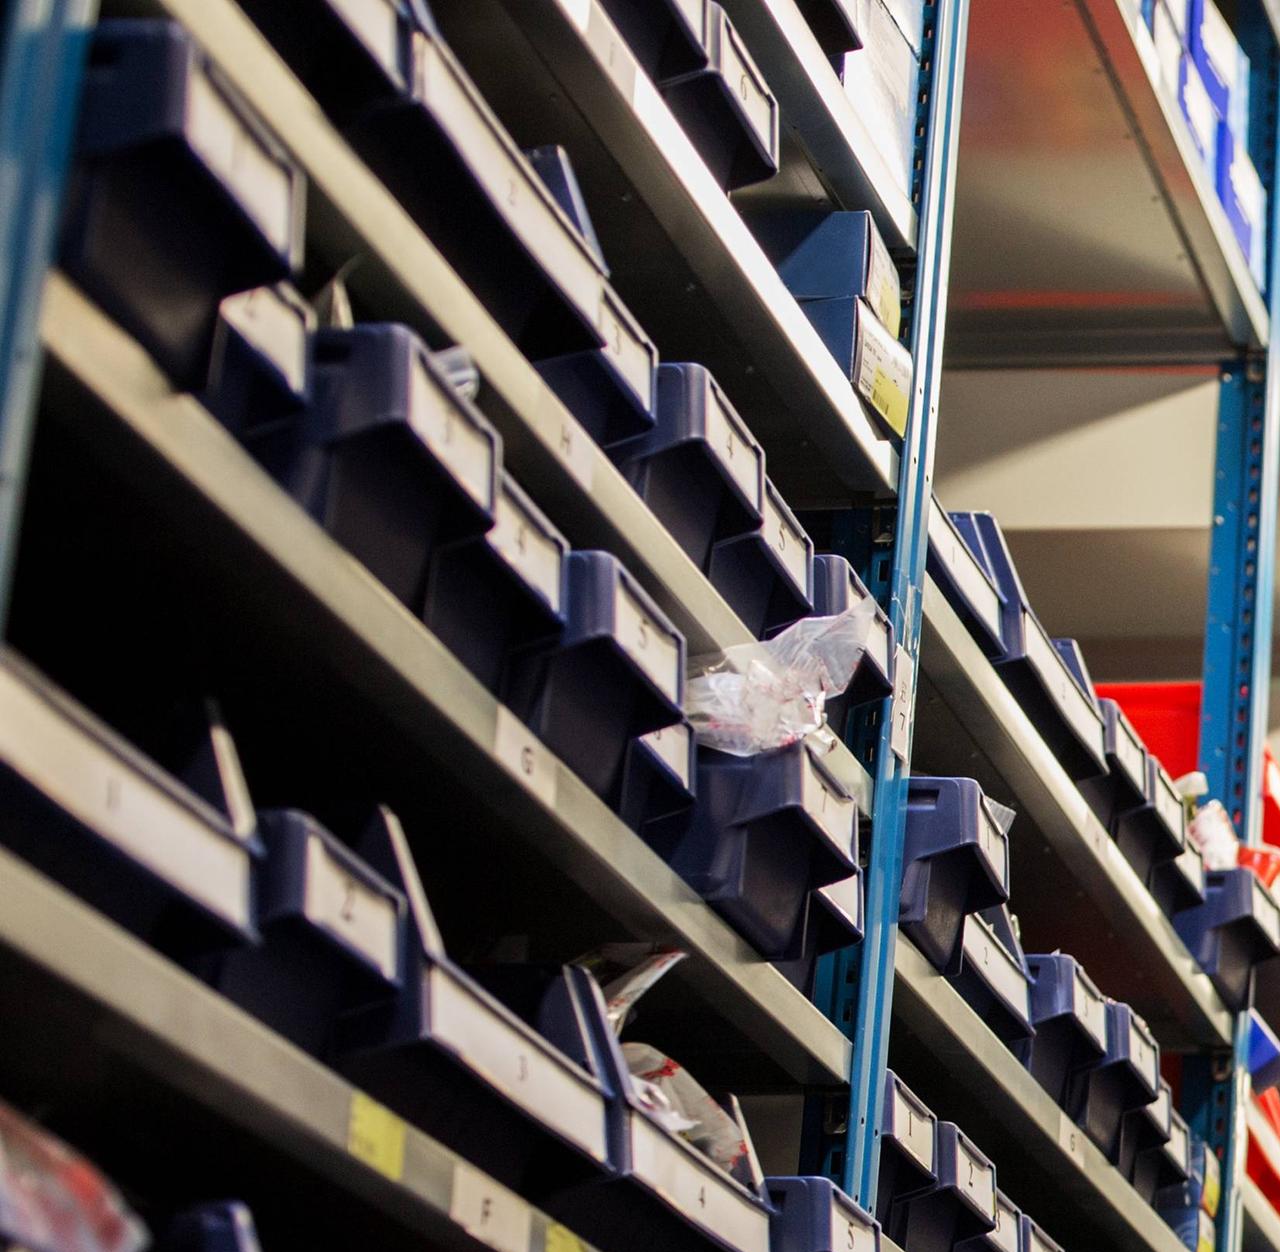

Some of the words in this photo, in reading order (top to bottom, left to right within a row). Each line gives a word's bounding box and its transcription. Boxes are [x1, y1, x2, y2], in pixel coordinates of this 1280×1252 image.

[779, 519, 787, 550] 5
[907, 1111, 913, 1138] 1
[967, 1160, 974, 1188] 2
[699, 1184, 706, 1209] 4
[847, 1222, 855, 1250] 5
